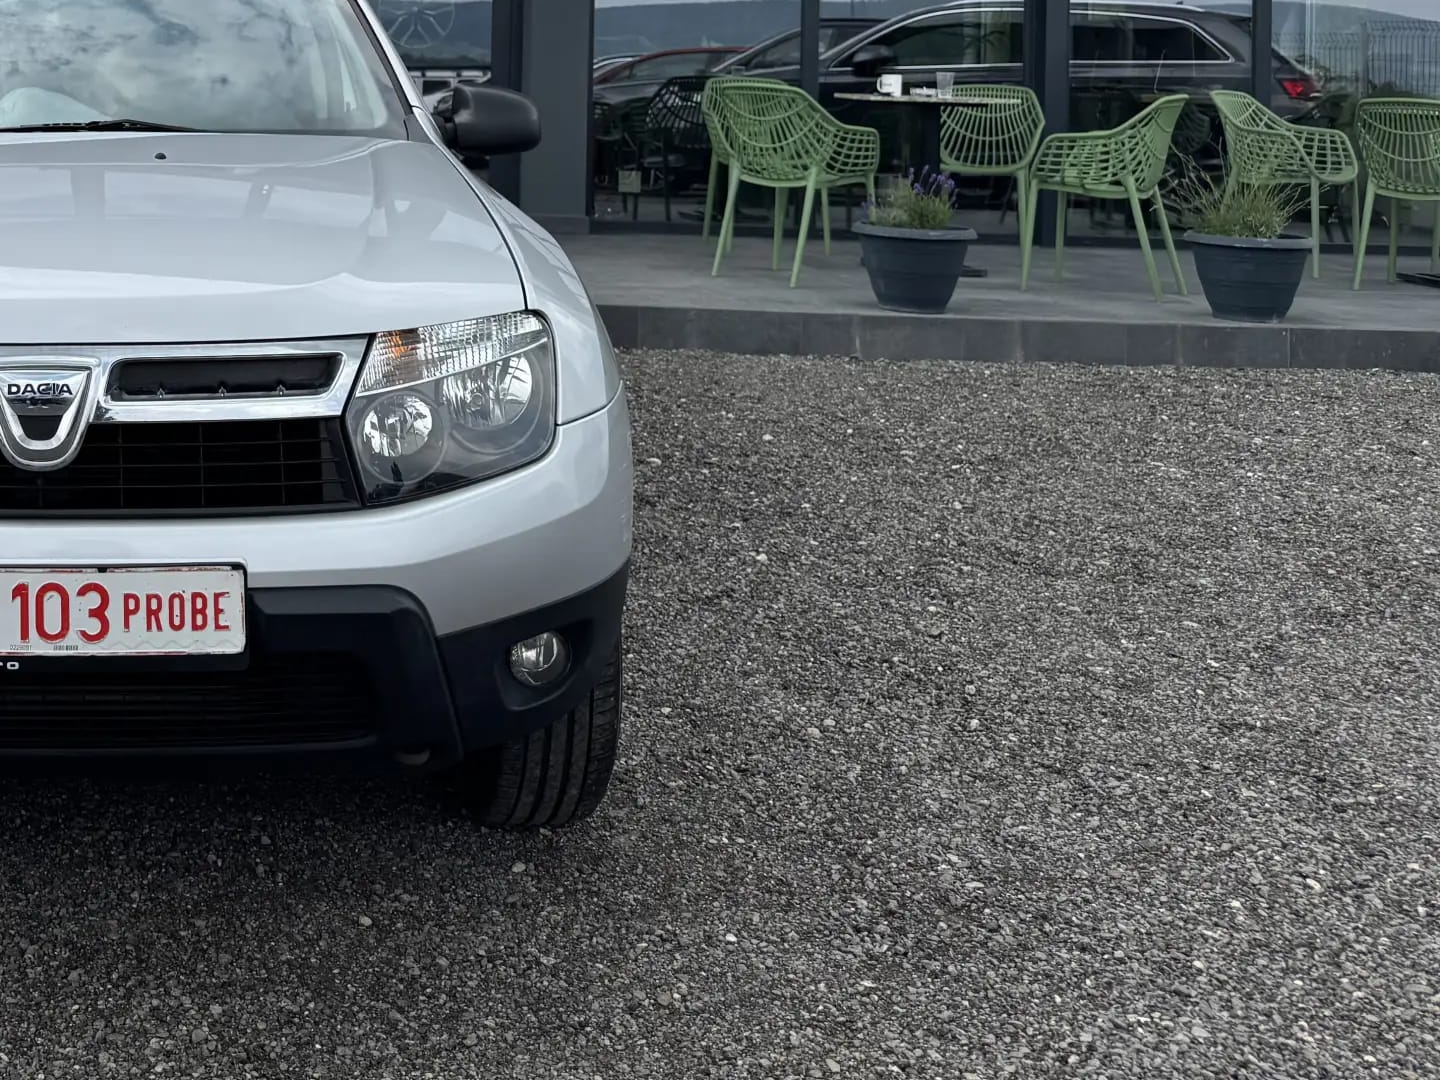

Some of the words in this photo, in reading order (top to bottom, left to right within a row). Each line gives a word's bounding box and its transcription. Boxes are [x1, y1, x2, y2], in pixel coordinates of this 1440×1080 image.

[7, 383, 73, 395] DACIA
[11, 581, 110, 644] 103
[123, 591, 232, 633] PROBE
